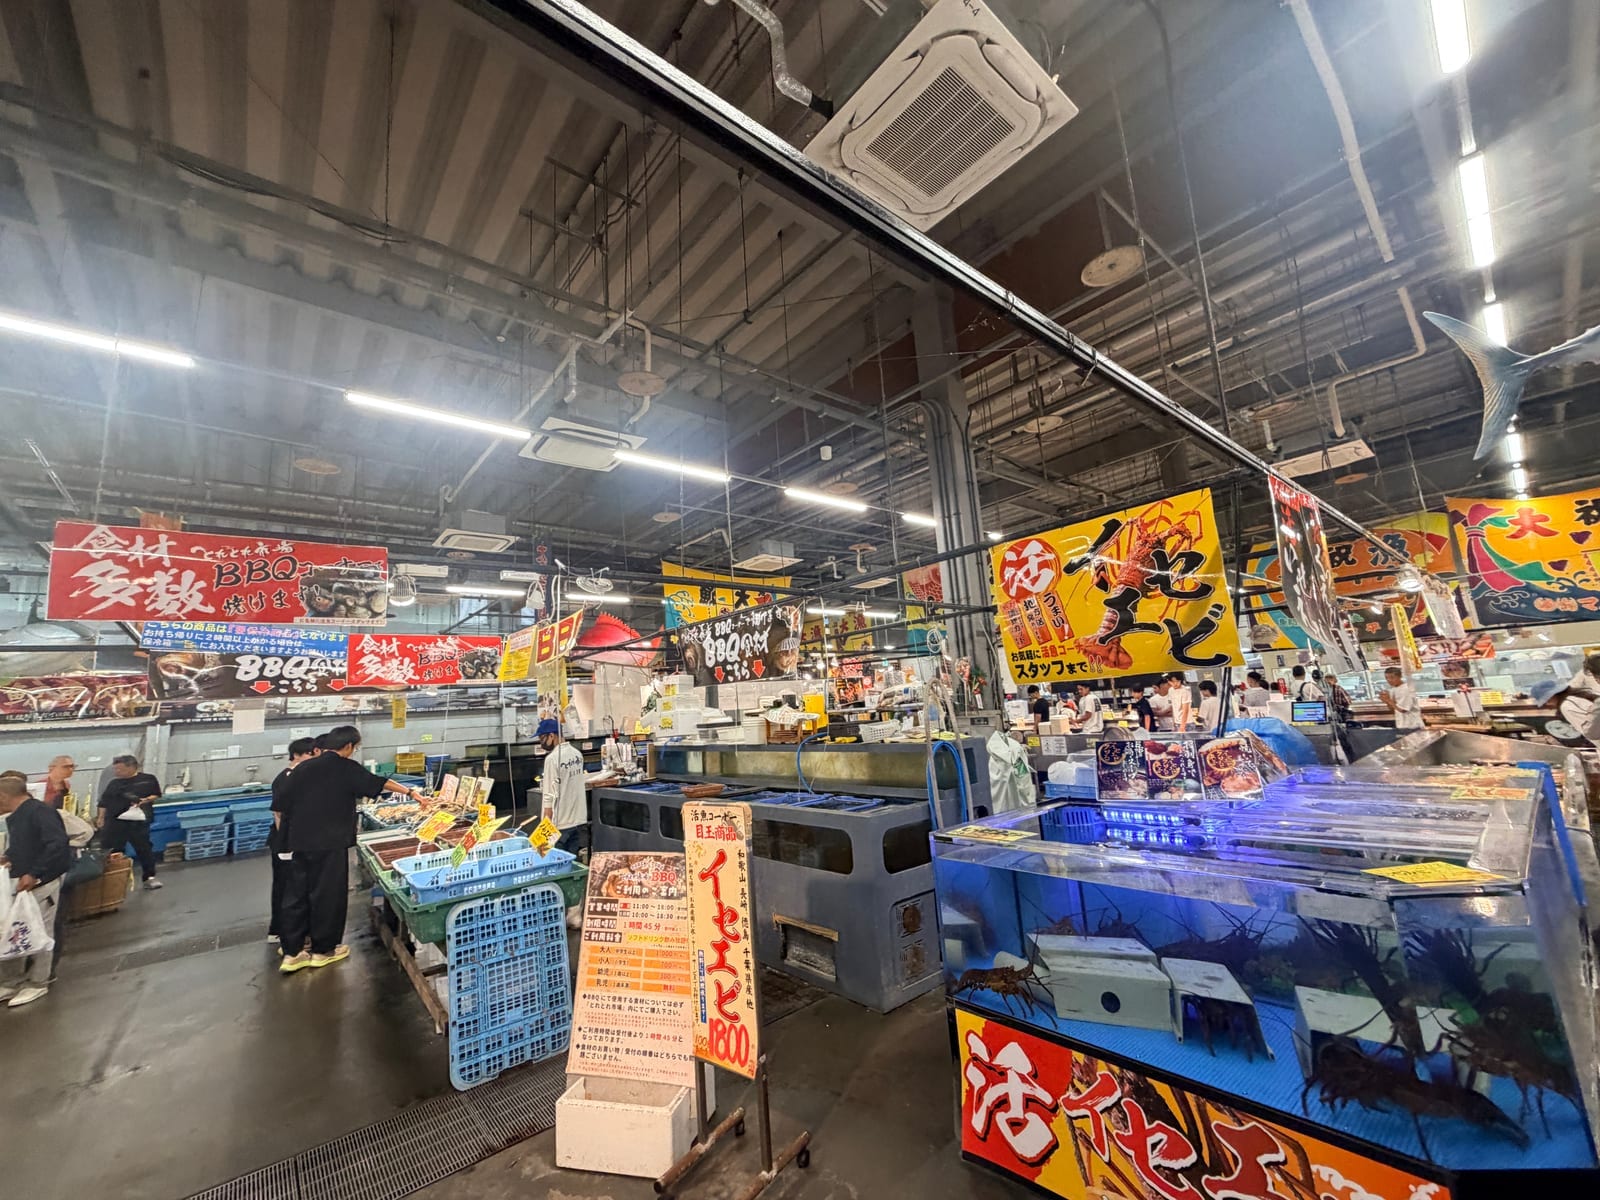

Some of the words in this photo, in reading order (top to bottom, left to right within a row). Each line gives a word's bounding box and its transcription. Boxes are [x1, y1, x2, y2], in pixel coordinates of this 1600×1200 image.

[1506, 507, 1560, 540] 大
[76, 525, 178, 568] 食材
[1003, 540, 1056, 597] 活
[69, 560, 215, 619] 多数
[1063, 518, 1231, 668] イセエビ
[356, 634, 401, 656] 食材
[356, 655, 420, 684] 多数
[726, 660, 751, 682] こちら
[278, 678, 319, 693] こちら
[695, 824, 737, 840] 目玉商品
[616, 885, 677, 897] ご利用のご案内
[651, 870, 678, 885] BBQ
[599, 946, 611, 954] 大人
[698, 849, 742, 1023] イセエビ
[598, 957, 610, 965] 小人
[708, 1017, 750, 1068] 1800
[965, 1030, 1059, 1164] 活
